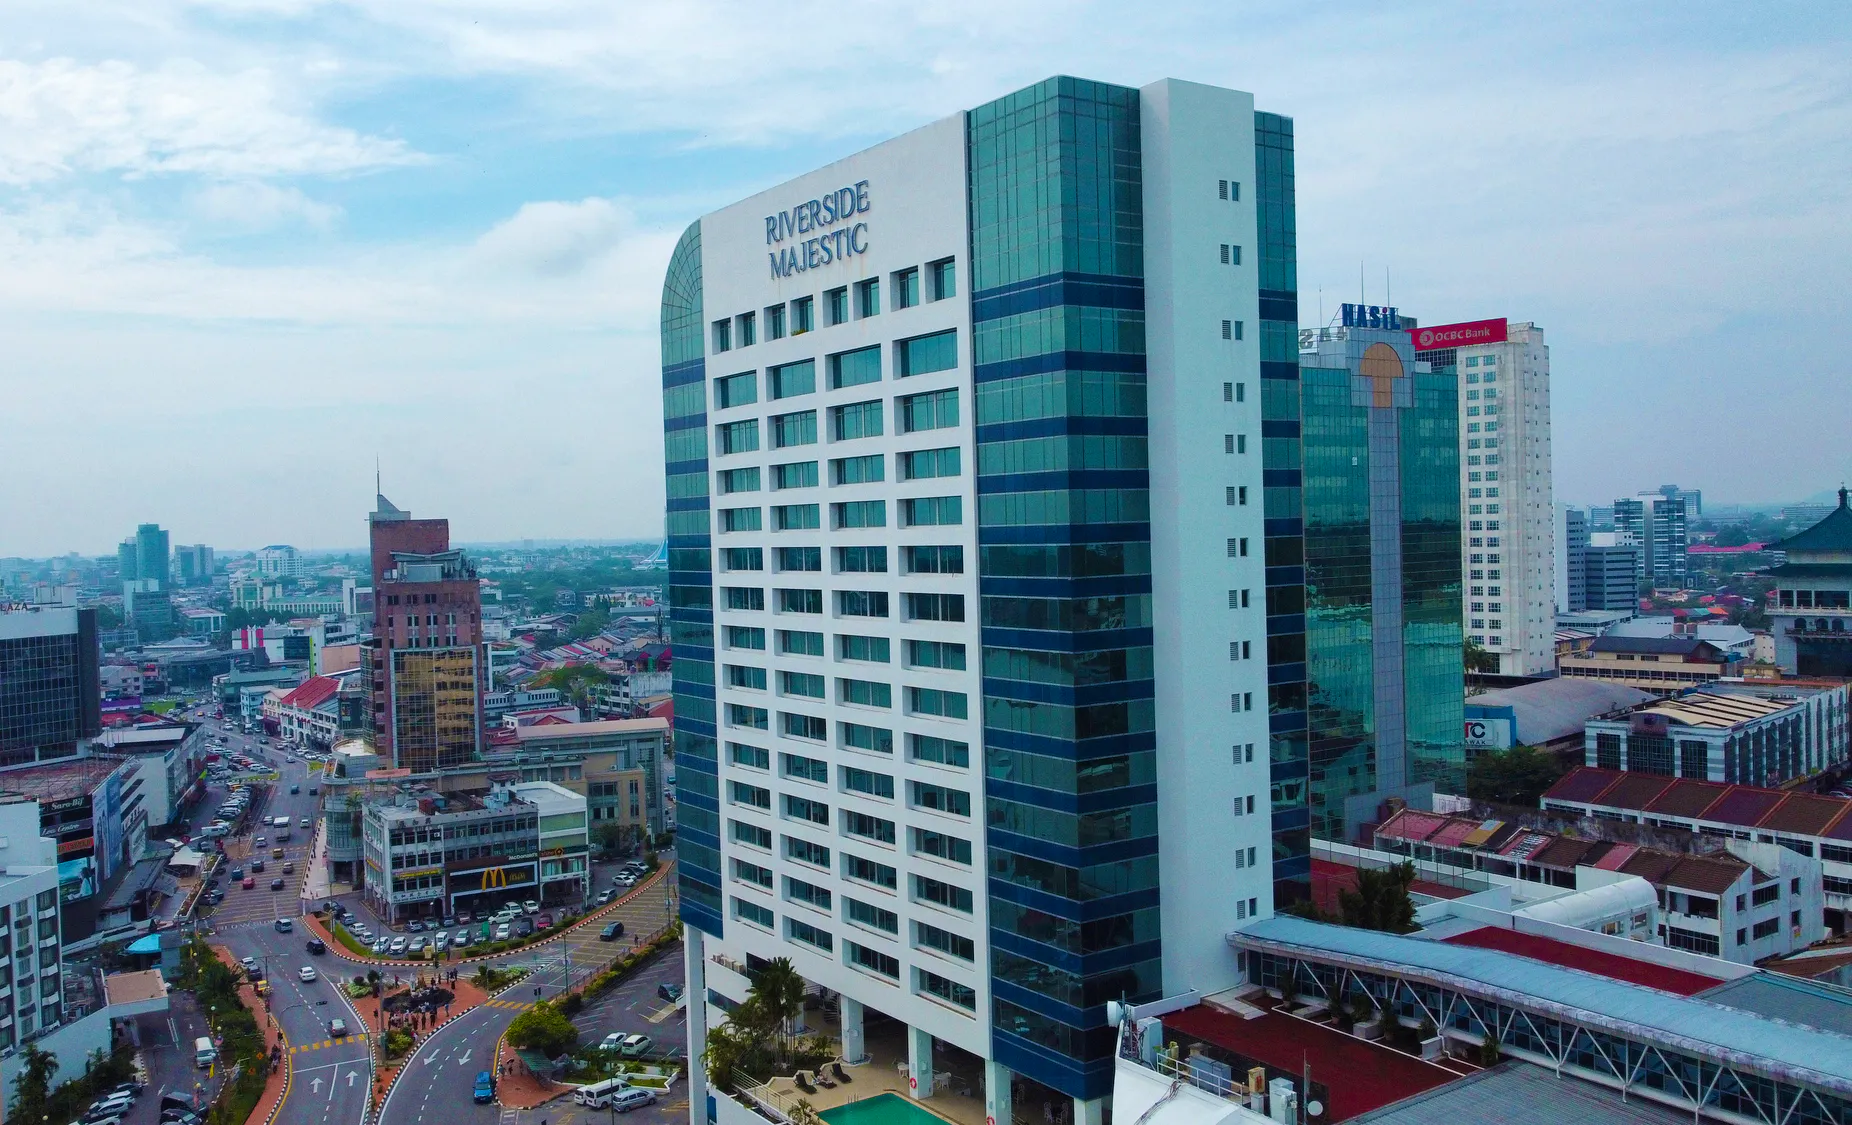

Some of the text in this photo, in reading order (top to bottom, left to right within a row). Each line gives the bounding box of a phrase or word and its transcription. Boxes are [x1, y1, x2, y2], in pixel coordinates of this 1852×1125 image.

[764, 180, 870, 245] RIVERSIDE
[769, 222, 868, 280] MAJESTIC
[1435, 327, 1490, 342] OCBC Bank
[0, 602, 28, 611] LAZA
[1464, 722, 1486, 739] TC
[508, 852, 538, 861] McDonald's
